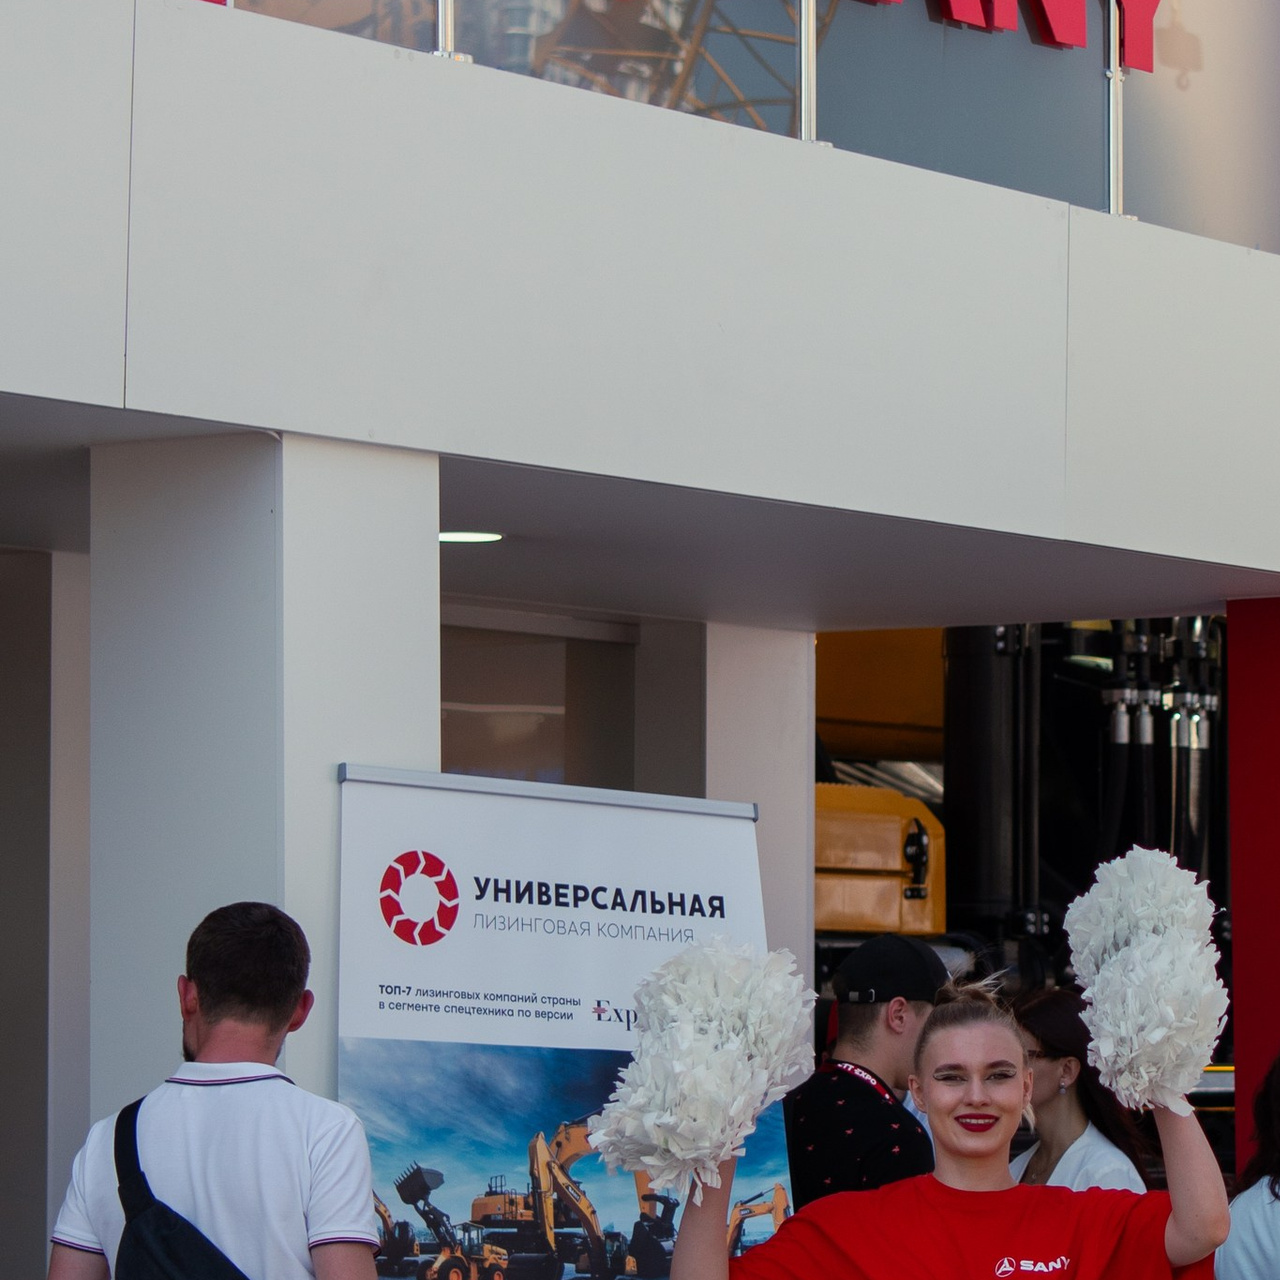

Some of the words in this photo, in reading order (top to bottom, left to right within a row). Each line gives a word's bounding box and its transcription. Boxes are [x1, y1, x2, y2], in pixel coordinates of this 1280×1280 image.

[474, 876, 726, 918] УНИВЕРСАЛЬНАЯ
[473, 913, 591, 936] ЛИЗИНГОВАЯ
[597, 922, 694, 943] КОМПАНИЯ
[378, 984, 412, 996] ТОП-7
[415, 988, 481, 1000] лизинговых
[483, 992, 538, 1004] компаний
[540, 995, 581, 1007] страны
[378, 1001, 385, 1009] в
[388, 1002, 441, 1012] сегменте
[444, 1004, 514, 1017] спецтехника
[518, 1009, 531, 1018] по
[534, 1009, 574, 1022] версии
[594, 999, 638, 1031] Exp
[1020, 1256, 1070, 1272] SANY
